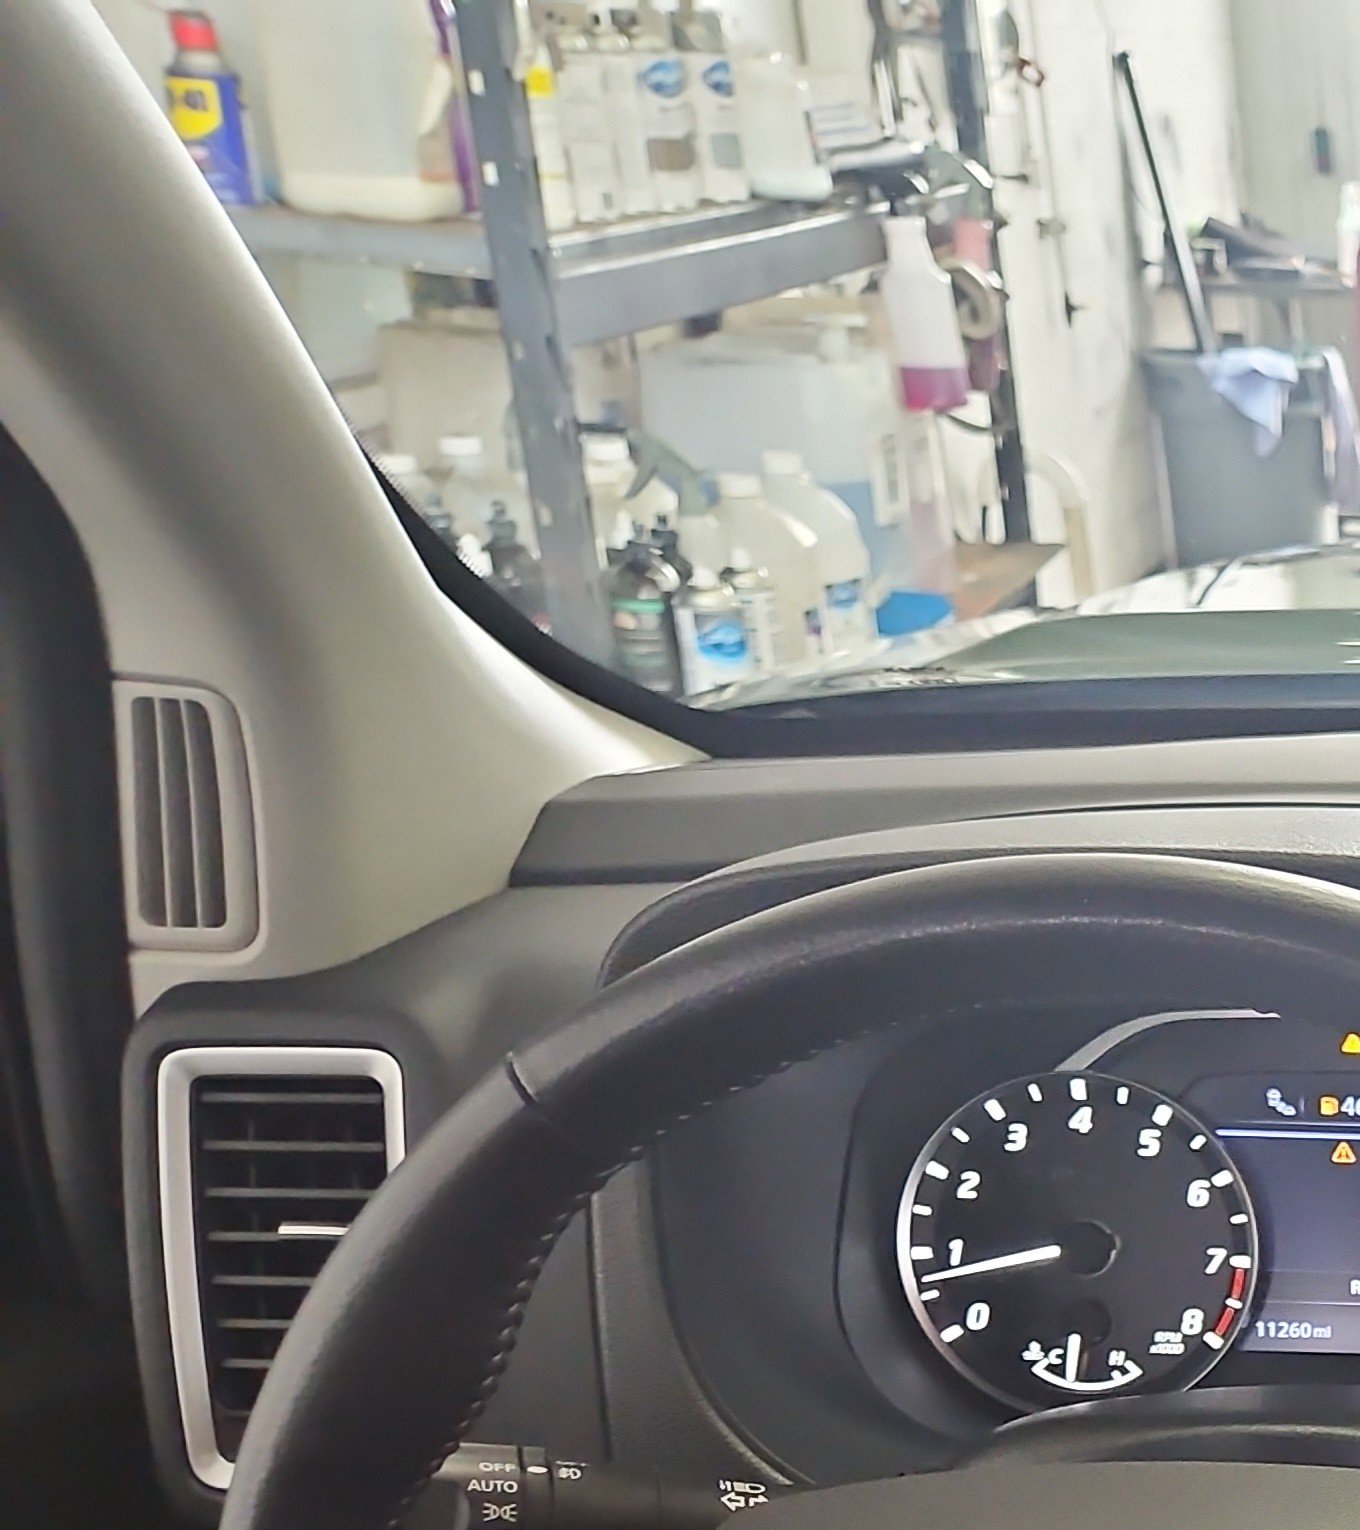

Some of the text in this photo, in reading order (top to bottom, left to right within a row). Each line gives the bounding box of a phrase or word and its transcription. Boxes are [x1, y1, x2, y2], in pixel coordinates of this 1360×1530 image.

[1068, 1107, 1093, 1134] 4
[1005, 1123, 1028, 1151] 3
[1137, 1128, 1162, 1157] 5
[956, 1172, 981, 1199] 2
[1187, 1179, 1211, 1207] 6
[947, 1239, 965, 1266] 1
[1205, 1247, 1228, 1275] 7
[966, 1302, 991, 1331] 0
[1180, 1308, 1204, 1335] 8
[1048, 1347, 1065, 1365] C
[478, 1461, 517, 1474] OFF
[467, 1479, 518, 1494] AUTO
